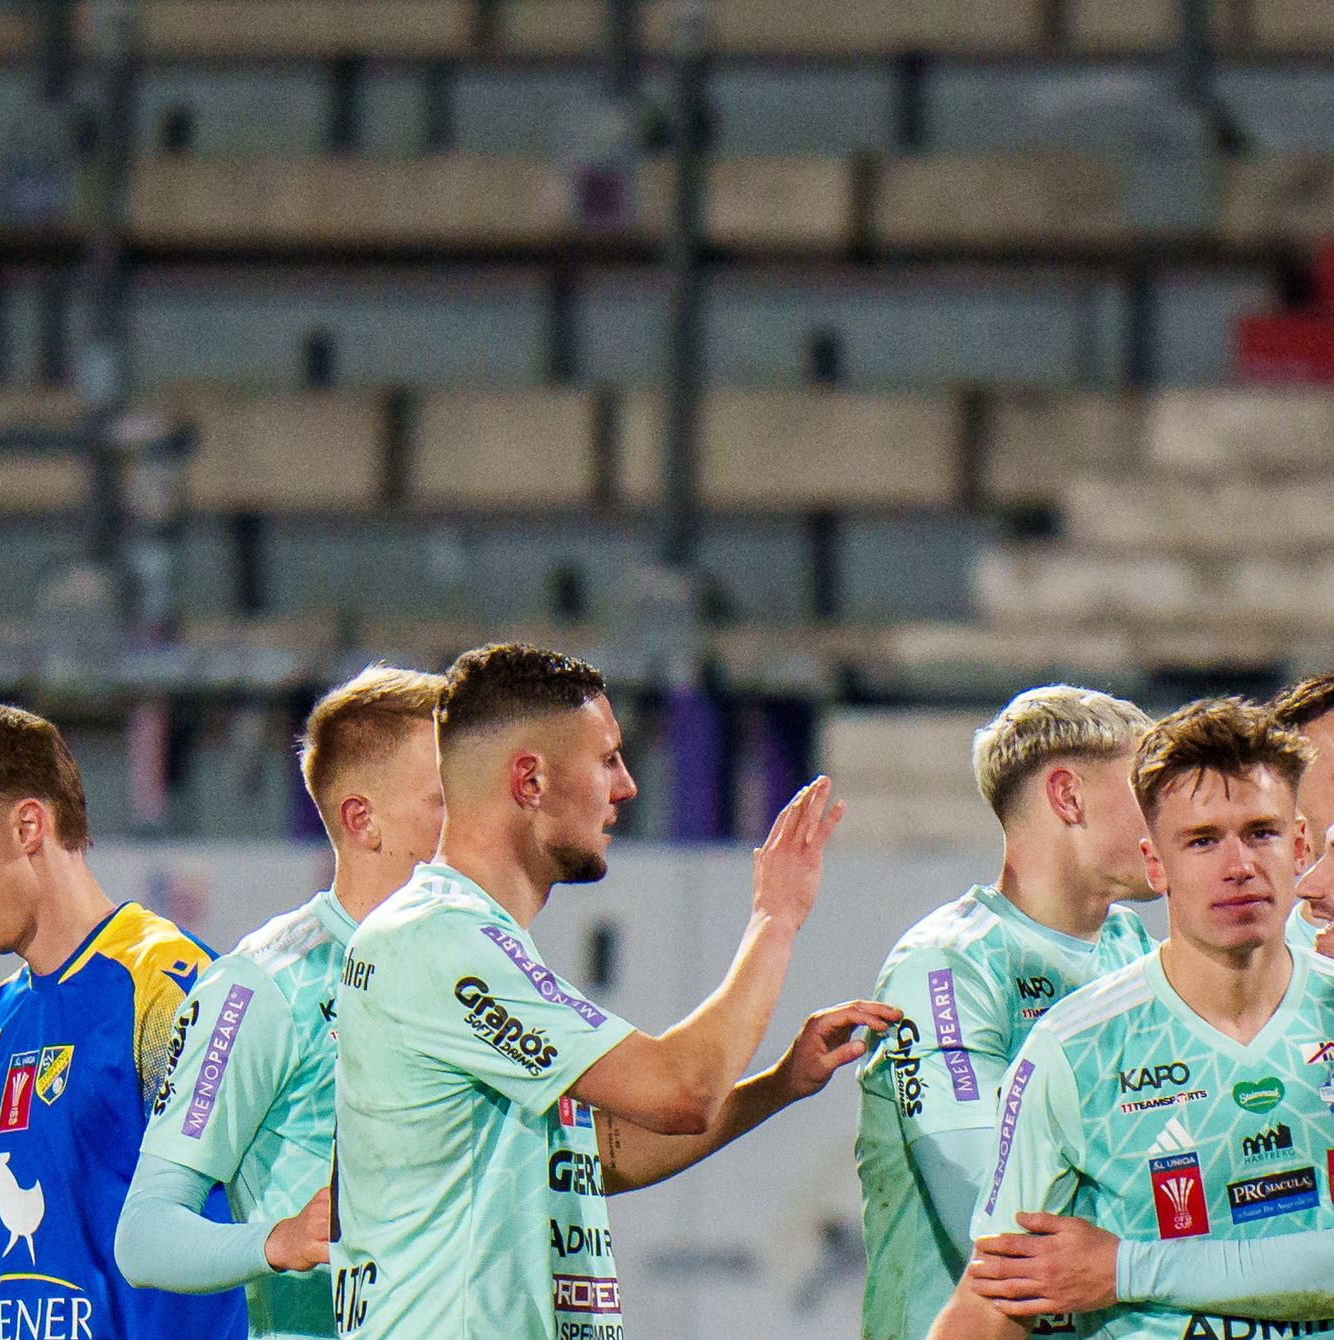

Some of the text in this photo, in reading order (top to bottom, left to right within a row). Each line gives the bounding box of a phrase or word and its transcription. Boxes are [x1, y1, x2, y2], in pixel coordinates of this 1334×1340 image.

[463, 1012, 543, 1077] SOFT DRINKS
[1120, 1061, 1191, 1094] KAPO
[1244, 1148, 1295, 1165] HARTBERG
